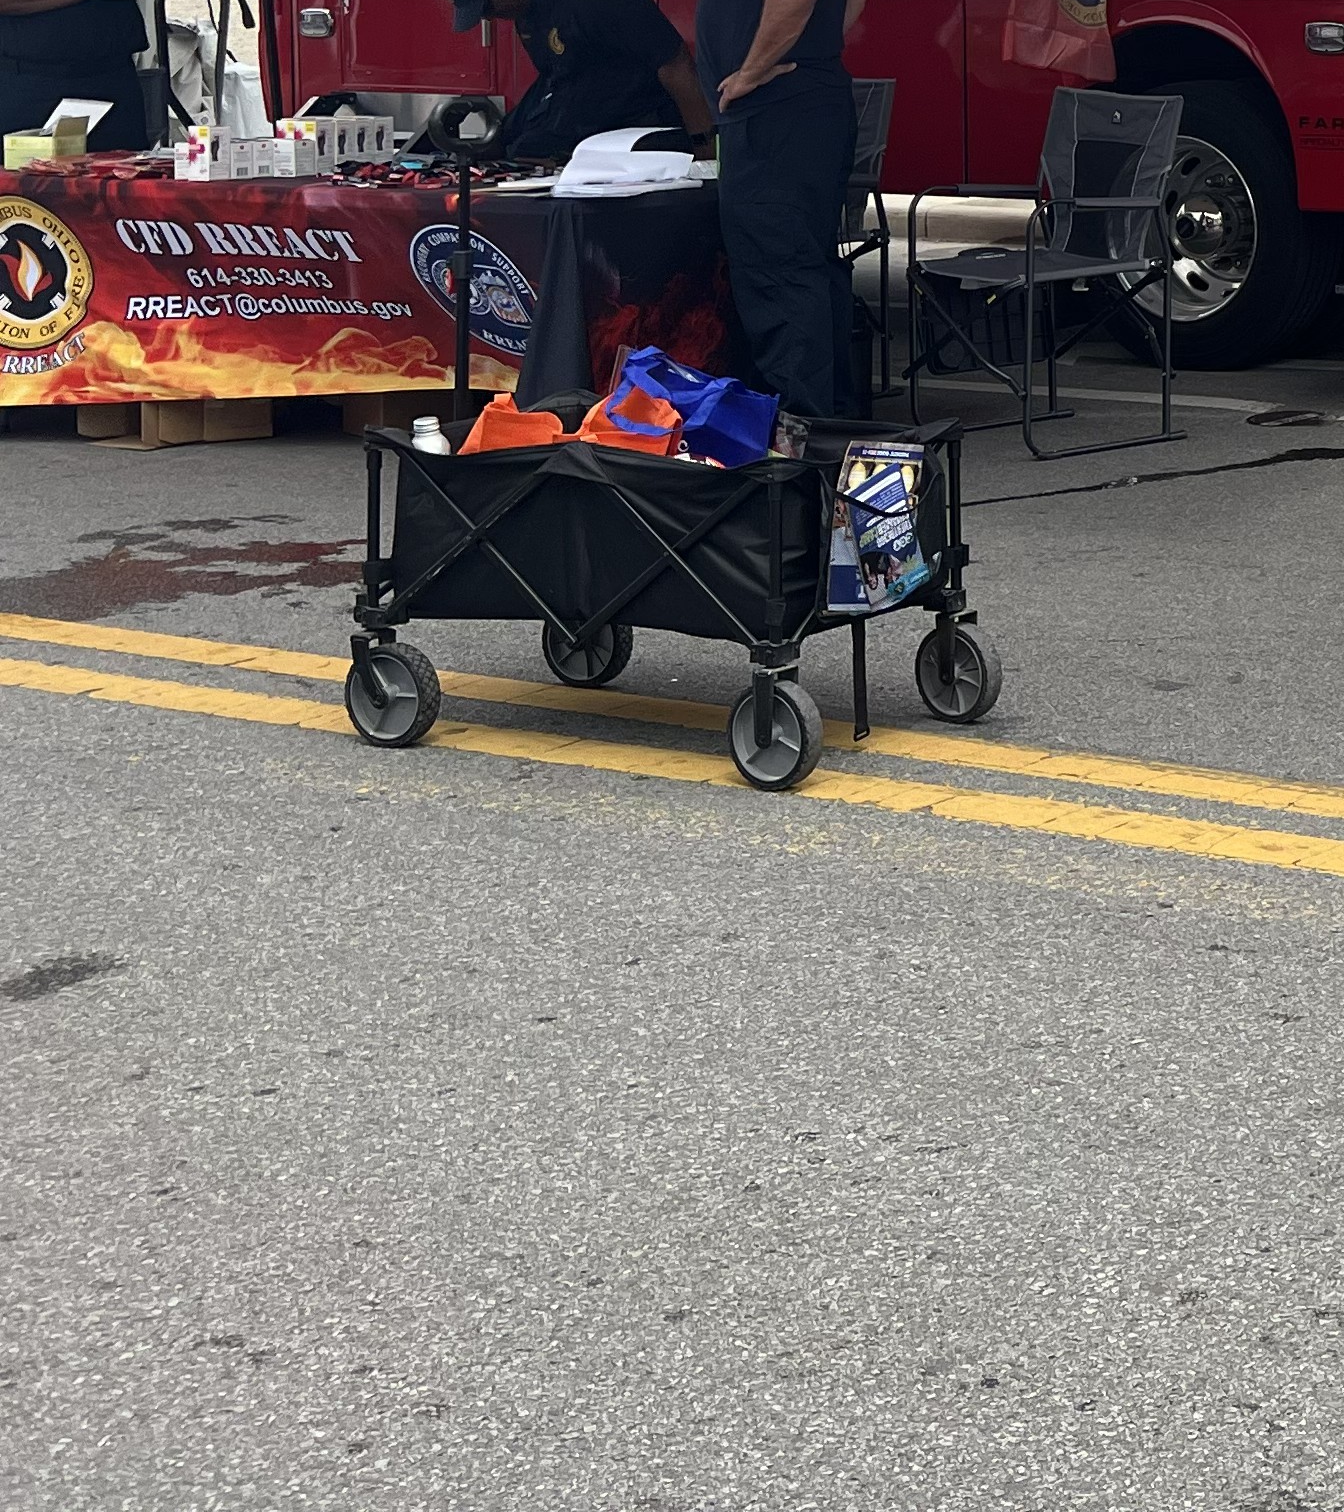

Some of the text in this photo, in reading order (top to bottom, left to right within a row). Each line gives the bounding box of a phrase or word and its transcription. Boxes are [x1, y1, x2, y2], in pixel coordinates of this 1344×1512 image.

[42, 216, 80, 263] OHIO
[115, 218, 363, 263] CFD RREACT
[187, 267, 334, 289] 614-330-3413
[491, 252, 529, 295] SUPPORT
[40, 321, 58, 337] OF
[63, 275, 85, 321] FIRE
[126, 294, 413, 321] RREACT@columbus.gov
[2, 331, 86, 375] RREACT
